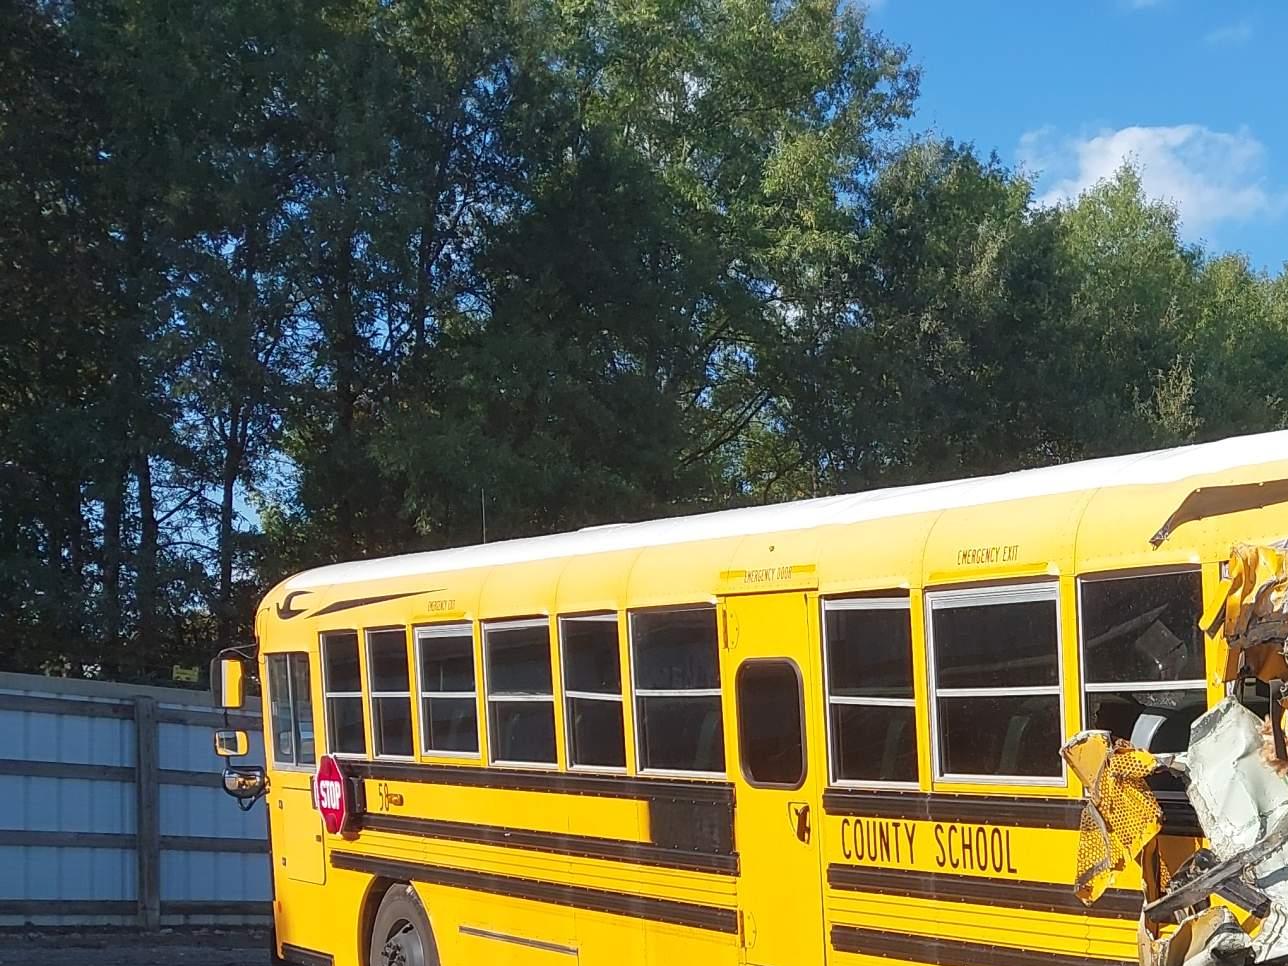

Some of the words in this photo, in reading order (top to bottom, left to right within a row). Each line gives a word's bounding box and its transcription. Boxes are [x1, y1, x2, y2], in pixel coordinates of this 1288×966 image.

[957, 547, 1000, 566] EMERGENCY
[1002, 545, 1018, 562] EXIT
[744, 567, 776, 584] EMERGENCY
[776, 566, 793, 580] DOOR
[320, 780, 342, 810] STOP
[841, 818, 916, 865] COUNTY
[934, 824, 1018, 874] SCHOOL
